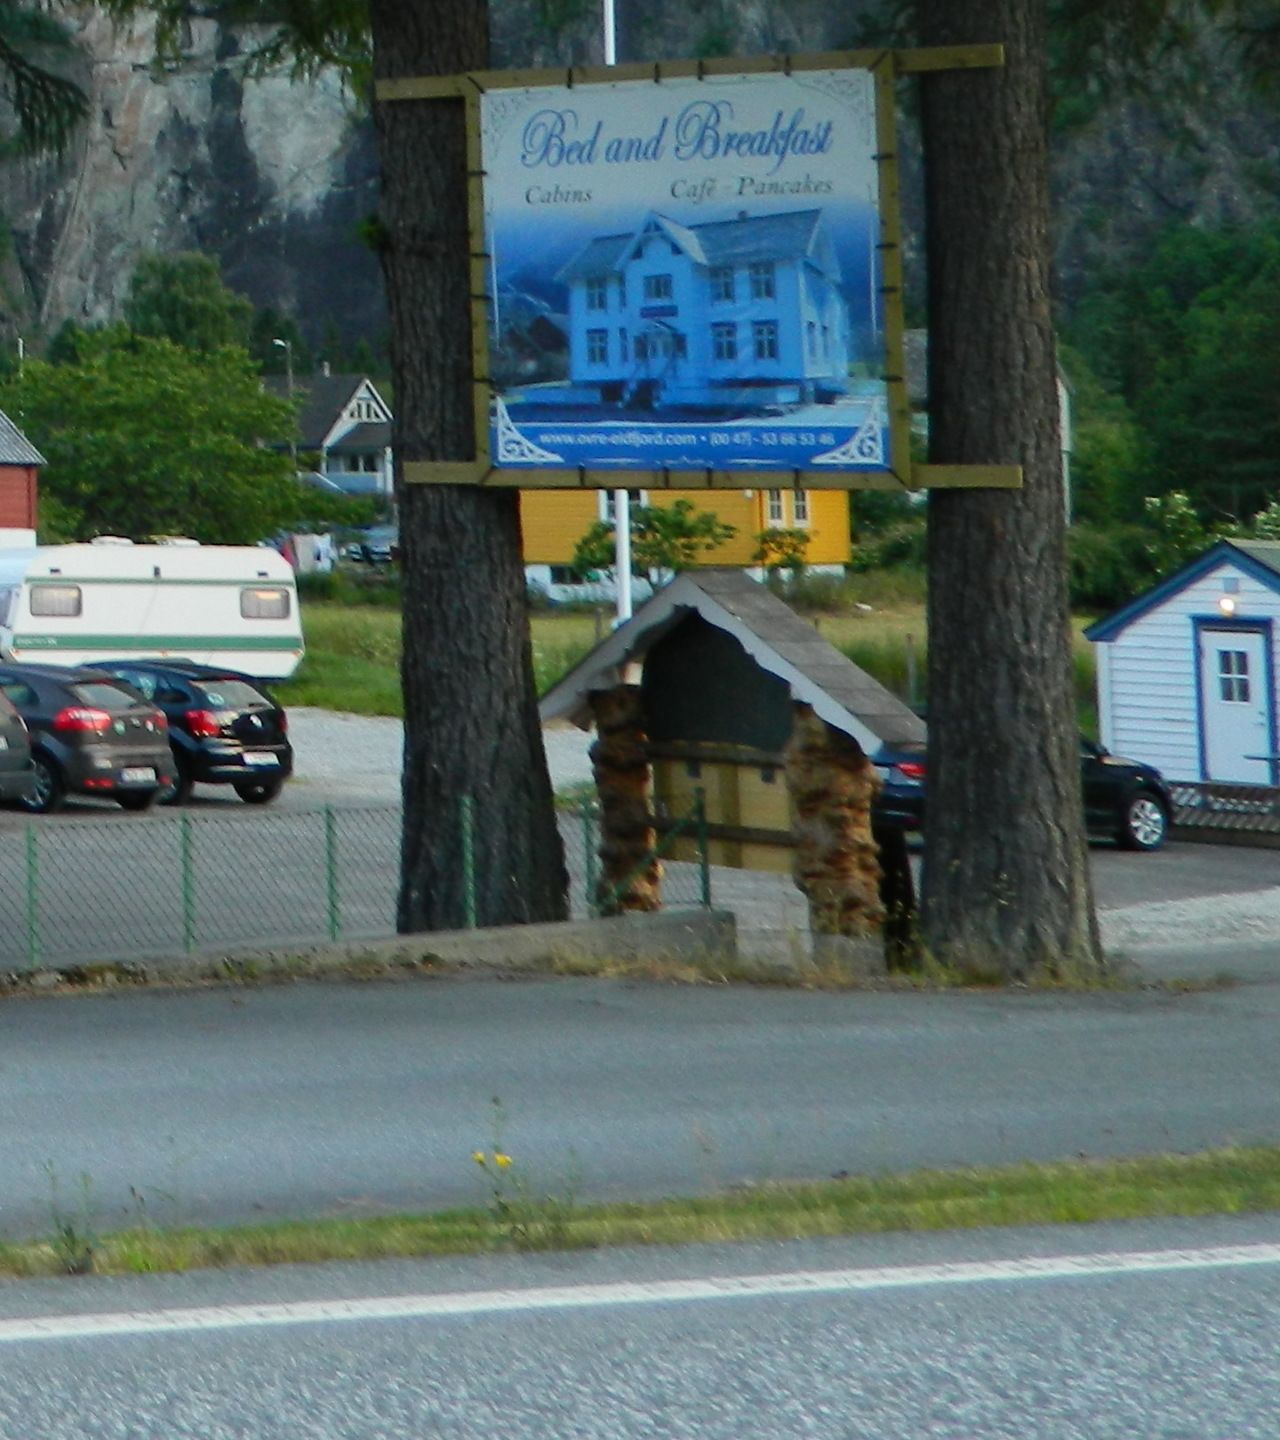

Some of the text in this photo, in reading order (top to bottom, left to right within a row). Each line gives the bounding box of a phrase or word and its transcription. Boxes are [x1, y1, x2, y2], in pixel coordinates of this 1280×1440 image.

[520, 100, 834, 177] Bed and Breakfast
[525, 184, 593, 205] Cabins
[737, 174, 834, 197] Pancakes
